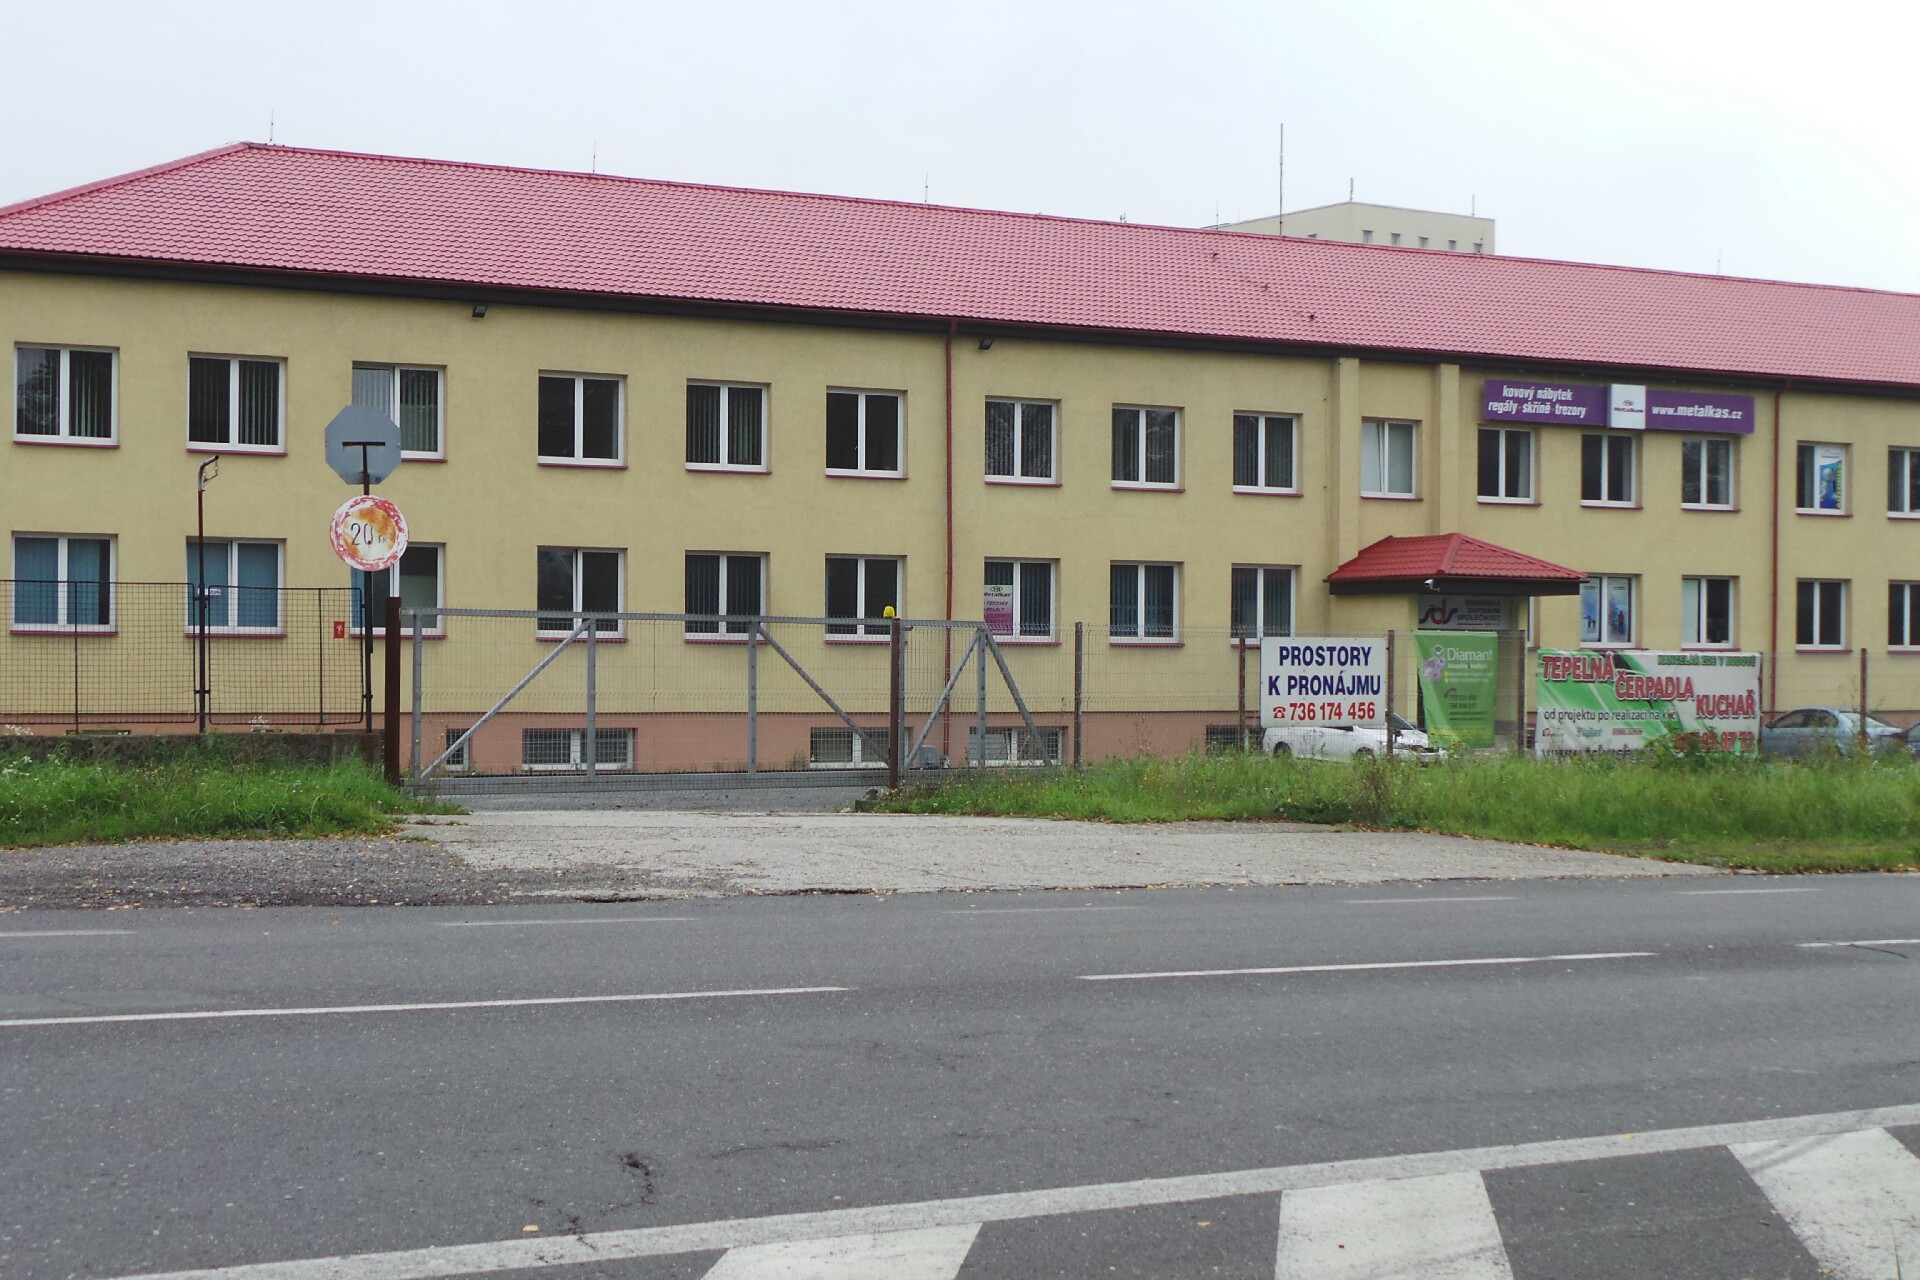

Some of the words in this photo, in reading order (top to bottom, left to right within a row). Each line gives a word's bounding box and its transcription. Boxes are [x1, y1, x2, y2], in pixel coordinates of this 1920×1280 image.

[1503, 385, 1535, 400] kovový
[1537, 387, 1573, 402] nábytek
[1488, 400, 1518, 414] regály
[1522, 401, 1551, 414] skříně
[1555, 403, 1587, 418] trezory
[1652, 405, 1743, 419] www.metalkas.cz
[350, 522, 374, 546] 20
[1279, 645, 1372, 667] PROSTORY
[1447, 647, 1494, 661] Diamant
[1542, 652, 1615, 681] TEPELNÁ
[1268, 675, 1281, 696] K
[1287, 671, 1381, 696] PRONÁJMU
[1615, 670, 1695, 700] ČERPADLA
[1289, 702, 1316, 721] 736
[1320, 702, 1343, 720] 174
[1347, 701, 1376, 720] 456
[1696, 689, 1756, 718] KUCHAŘ
[1543, 708, 1556, 720] od
[1558, 708, 1596, 724] projektu
[1598, 710, 1610, 723] po
[1612, 708, 1648, 720] realizaci
[1650, 711, 1660, 720] na
